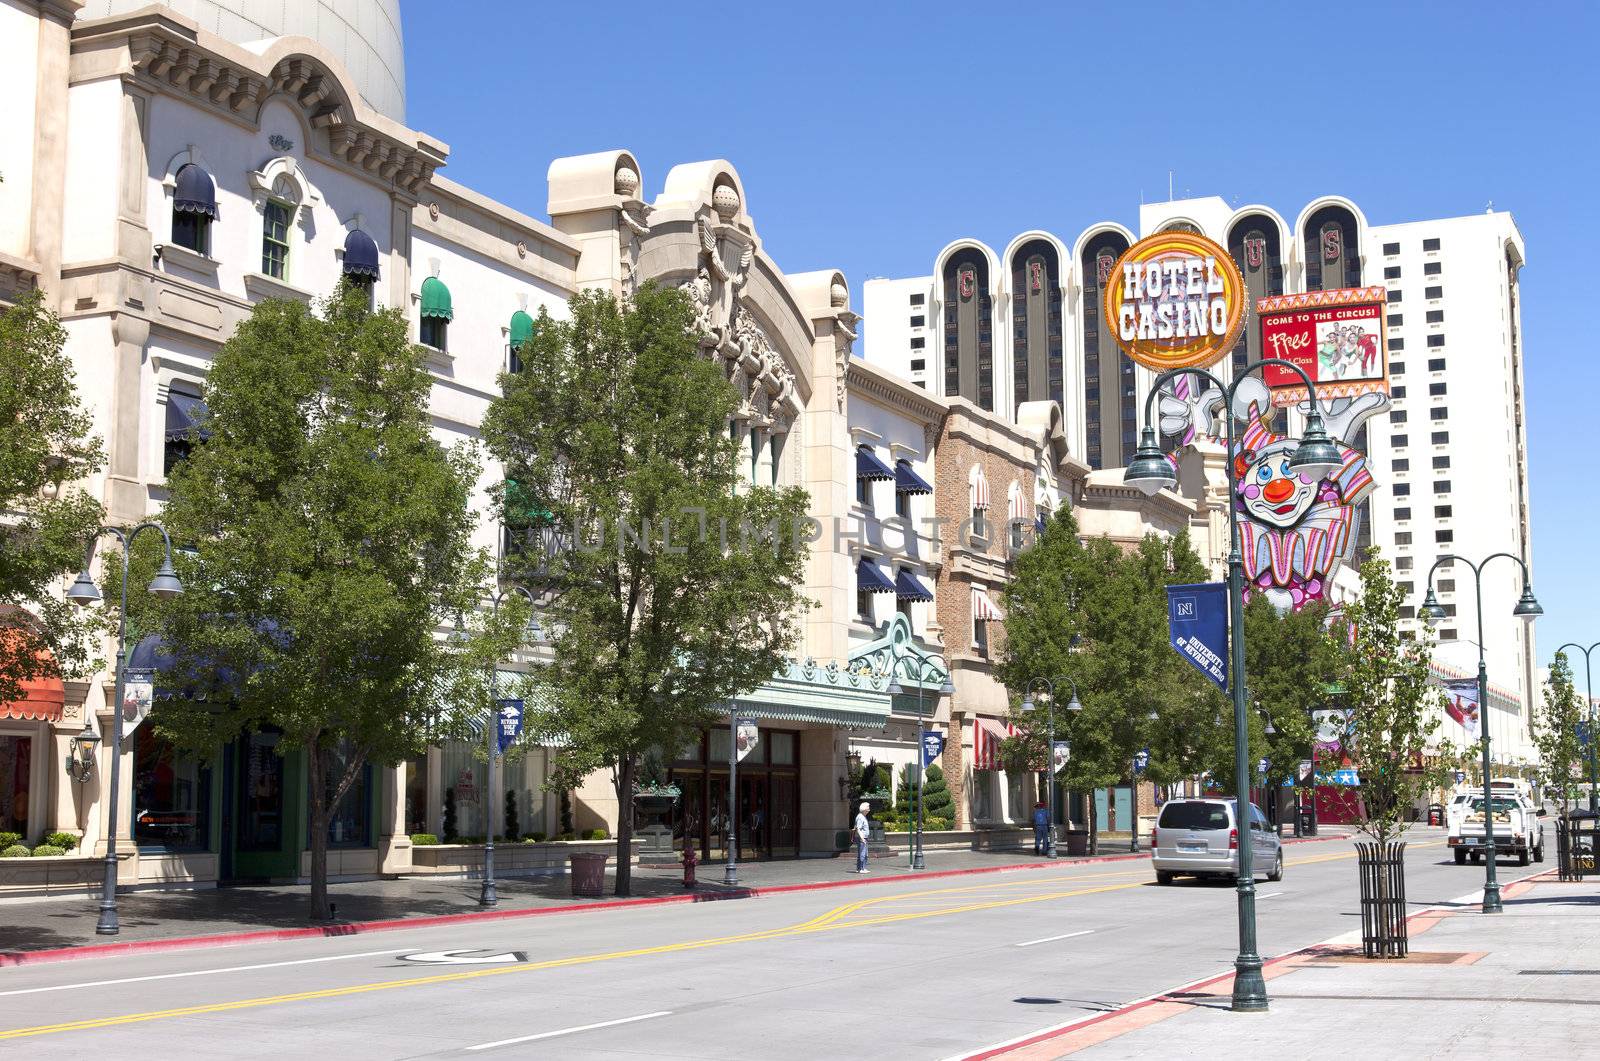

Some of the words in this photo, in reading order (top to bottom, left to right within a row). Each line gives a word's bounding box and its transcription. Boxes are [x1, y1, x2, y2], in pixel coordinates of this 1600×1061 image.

[1122, 256, 1224, 299] HOTEL
[1119, 297, 1228, 341] CASINO
[1266, 316, 1293, 326] COME
[1297, 314, 1310, 323] TO
[1313, 312, 1332, 320] THE
[1336, 308, 1375, 319] CIRCUS!
[1268, 331, 1312, 360] Free
[1178, 602, 1193, 615] N
[1176, 636, 1188, 648] OF
[1184, 643, 1211, 671] NEVADA,
[1208, 664, 1226, 683] RENO
[1188, 635, 1225, 669] UNIVERSITY
